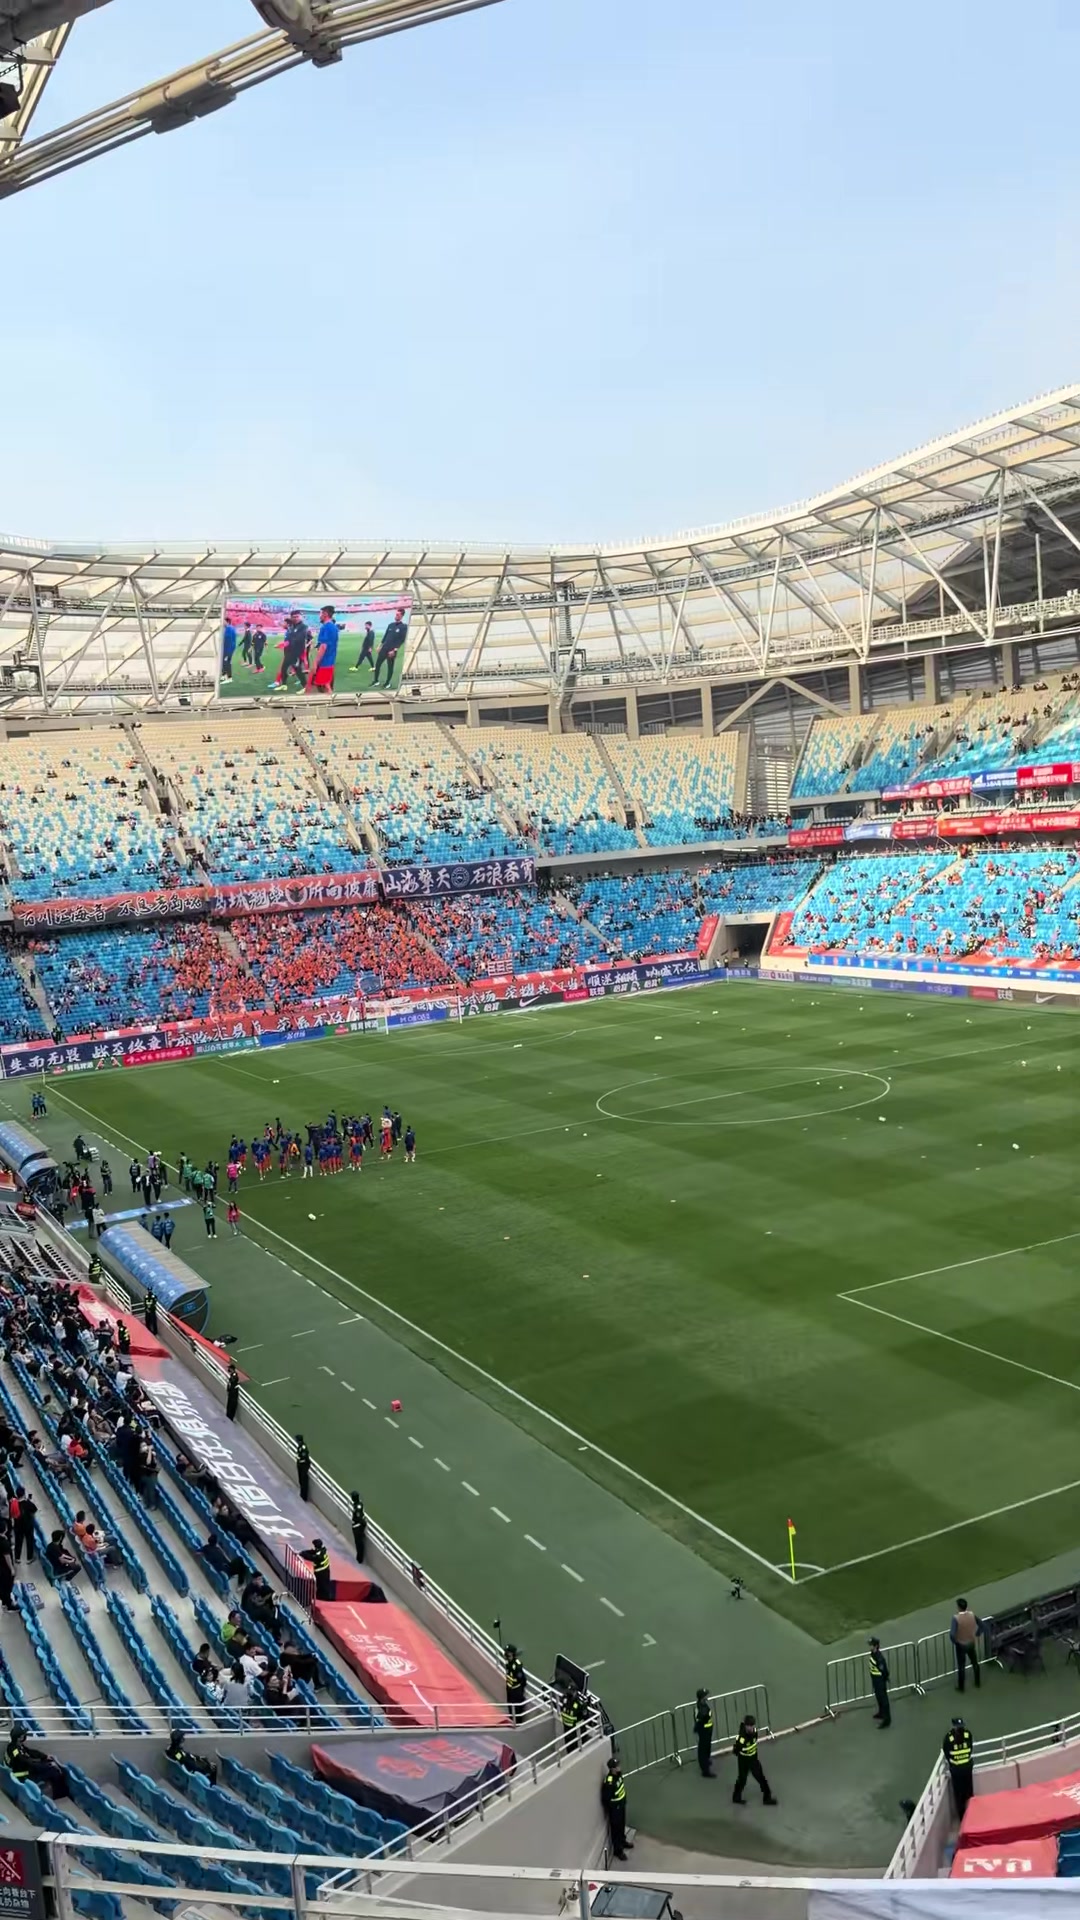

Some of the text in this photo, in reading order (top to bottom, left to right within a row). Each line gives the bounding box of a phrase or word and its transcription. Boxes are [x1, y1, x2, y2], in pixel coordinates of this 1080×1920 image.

[308, 875, 378, 903] 所向披靡
[565, 988, 588, 1000] Lenovo
[9, 1046, 82, 1074] 生而无畏
[92, 1035, 163, 1059] 战至终章
